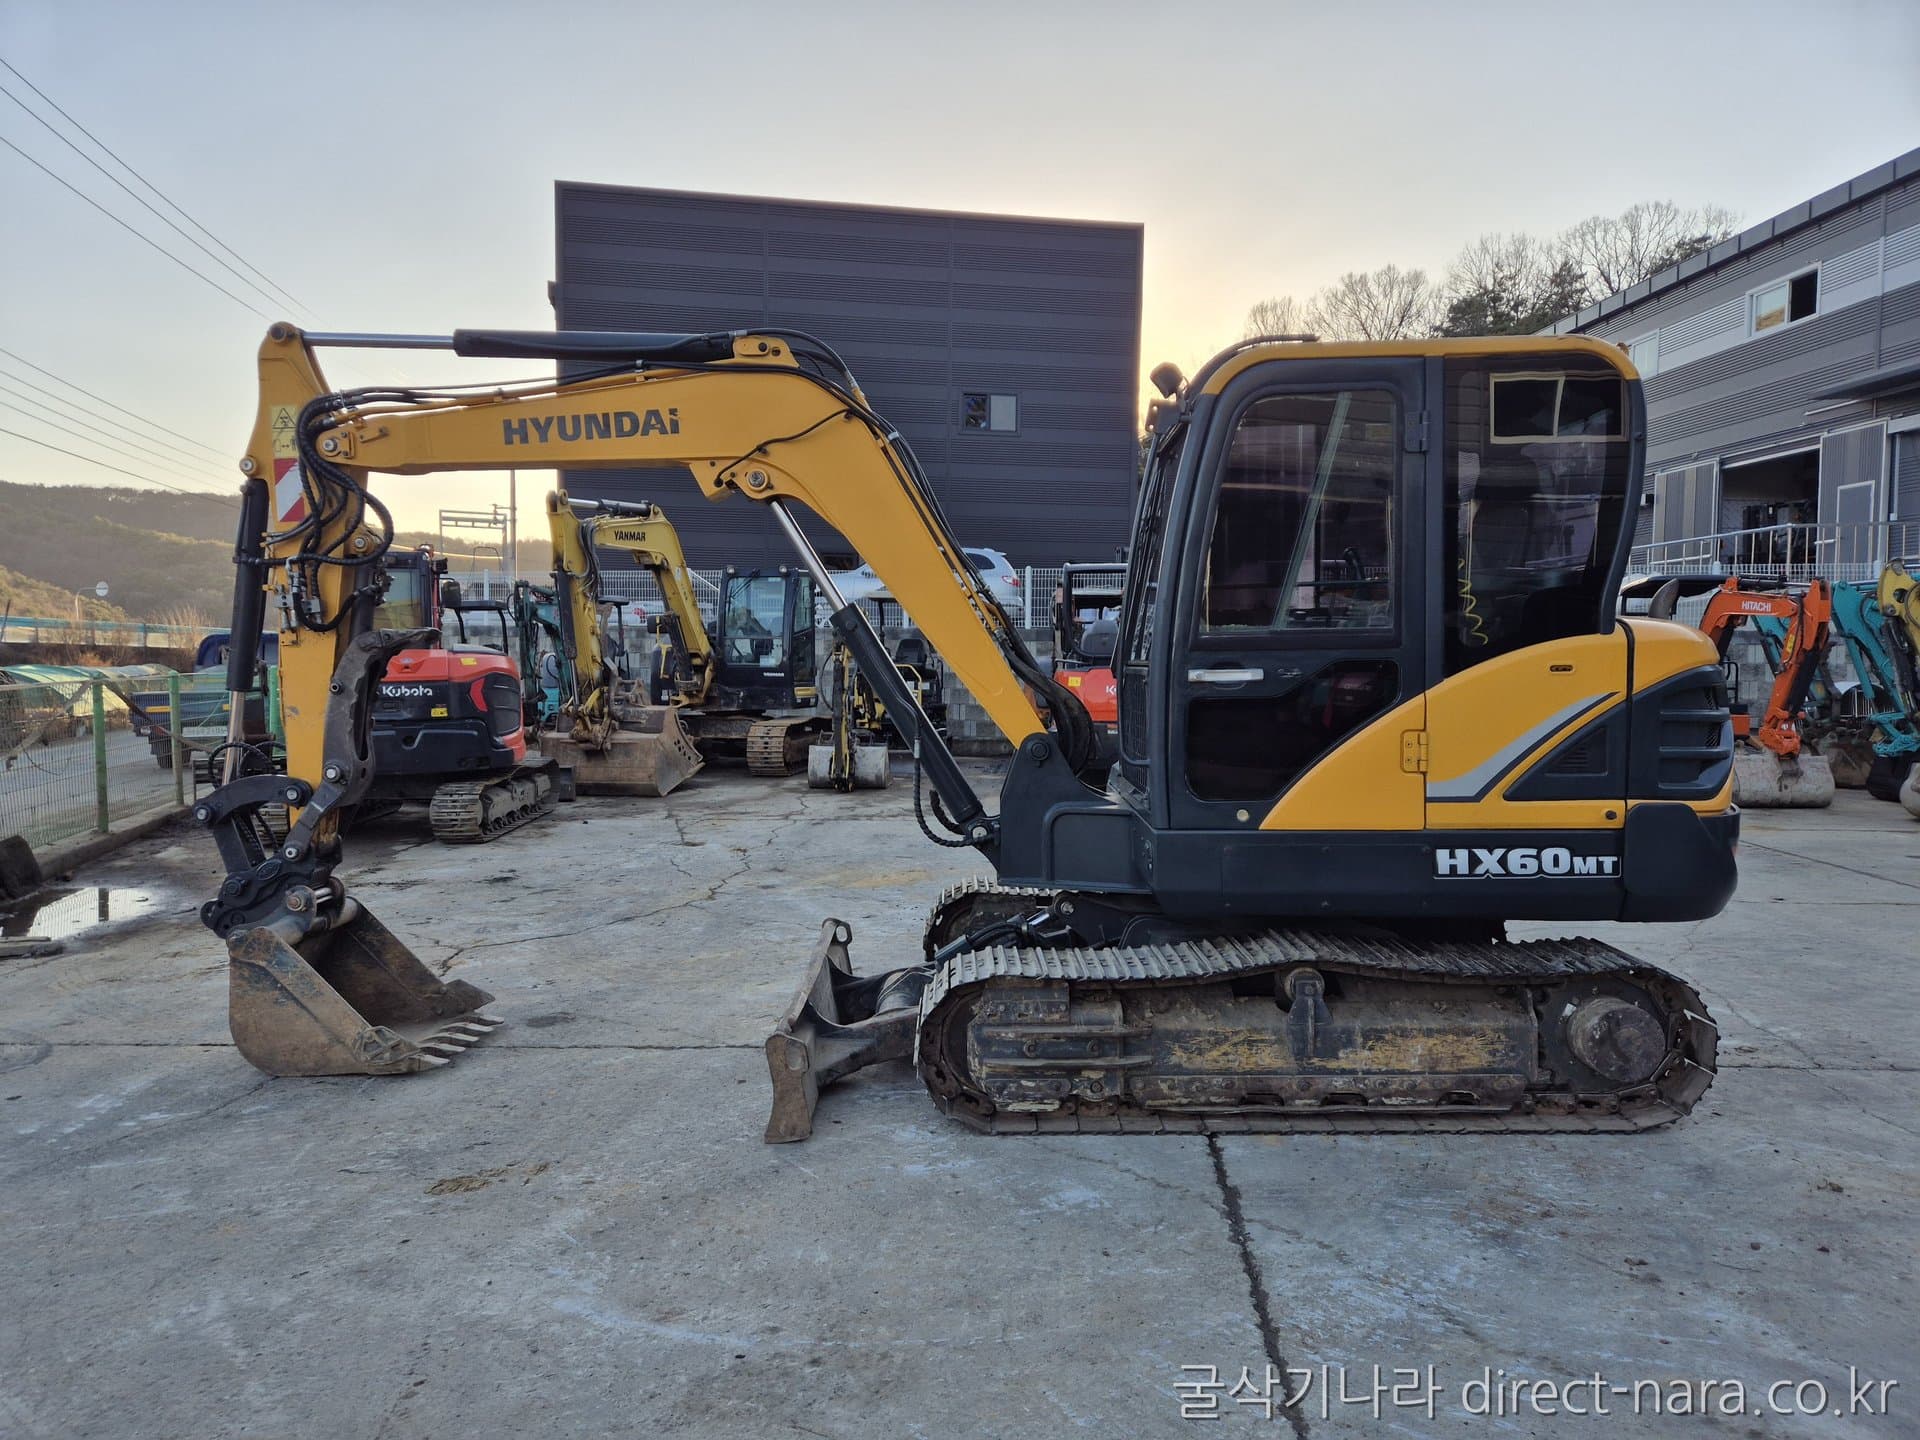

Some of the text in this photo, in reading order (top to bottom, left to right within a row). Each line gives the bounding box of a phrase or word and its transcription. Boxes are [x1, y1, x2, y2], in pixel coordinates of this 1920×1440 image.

[614, 530, 646, 542] YANMAR
[1741, 600, 1772, 612] HITACHI
[382, 684, 433, 697] Kubota
